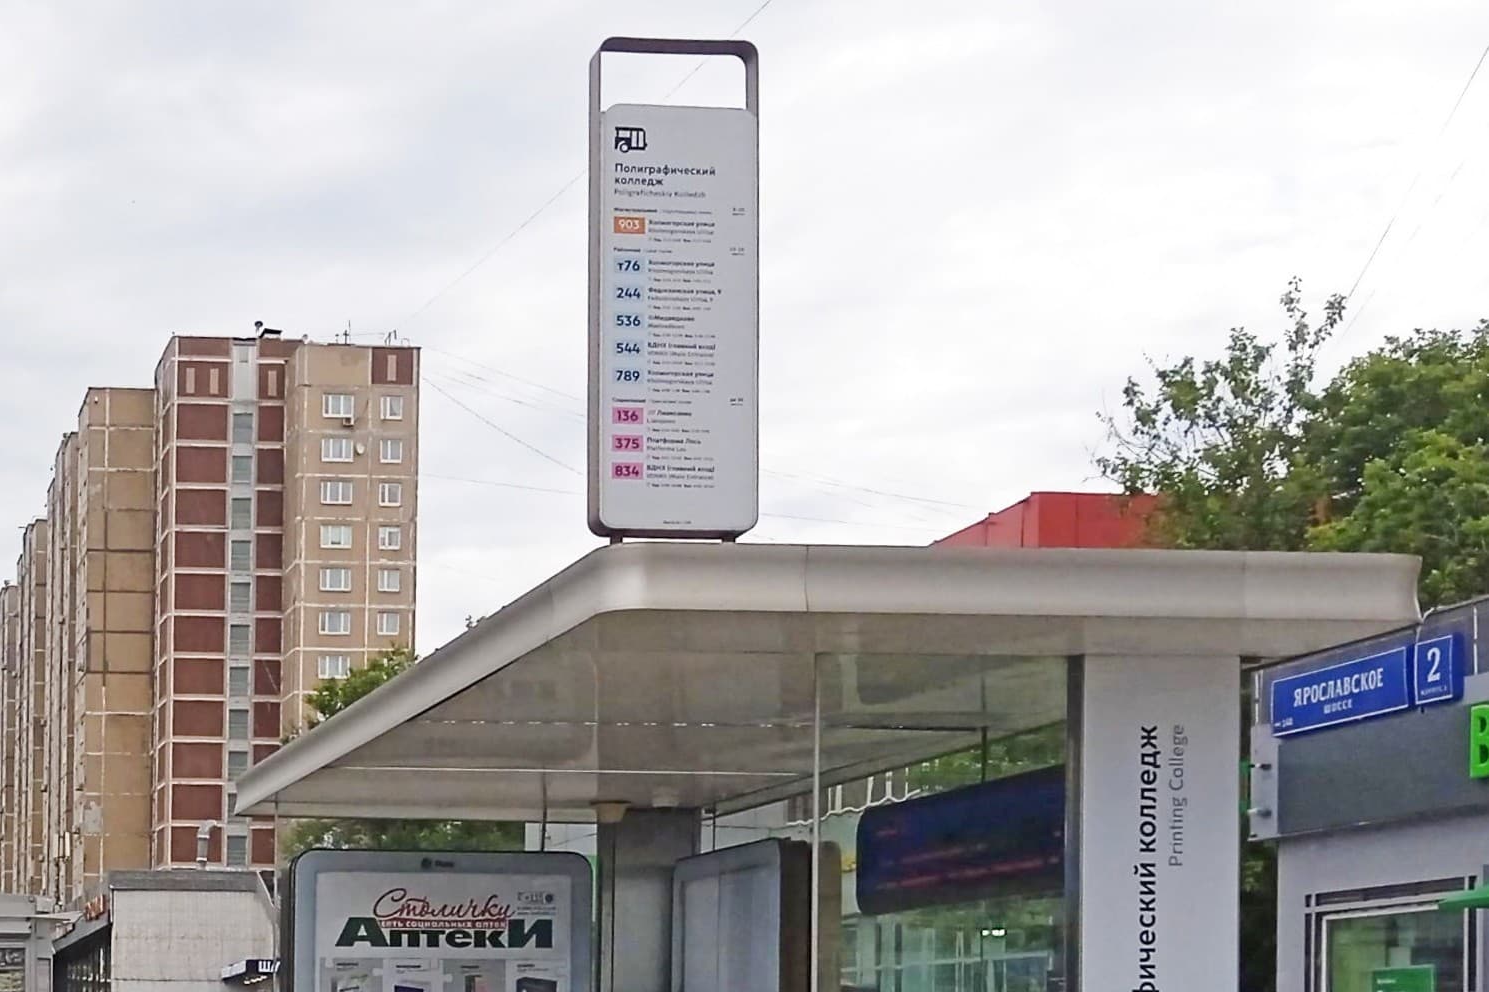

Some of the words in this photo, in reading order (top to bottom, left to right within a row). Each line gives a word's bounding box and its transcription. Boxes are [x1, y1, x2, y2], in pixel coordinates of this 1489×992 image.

[614, 162, 717, 176] Полиграфический
[614, 177, 664, 187] колледж
[618, 218, 640, 230] 903
[616, 287, 641, 299] 244
[616, 315, 641, 326] 536
[616, 342, 641, 354] 544
[616, 370, 641, 382] 789
[616, 410, 640, 422] 136
[614, 437, 640, 449] 375
[614, 465, 640, 477] 834
[1427, 647, 1441, 682] 2
[1293, 667, 1384, 707] ЯРОСЛАВСКОЕ
[1168, 724, 1188, 791] College
[1139, 725, 1161, 853] колледж
[1168, 797, 1188, 867] Printing
[373, 887, 517, 919] Столички
[406, 920, 473, 930] социальных
